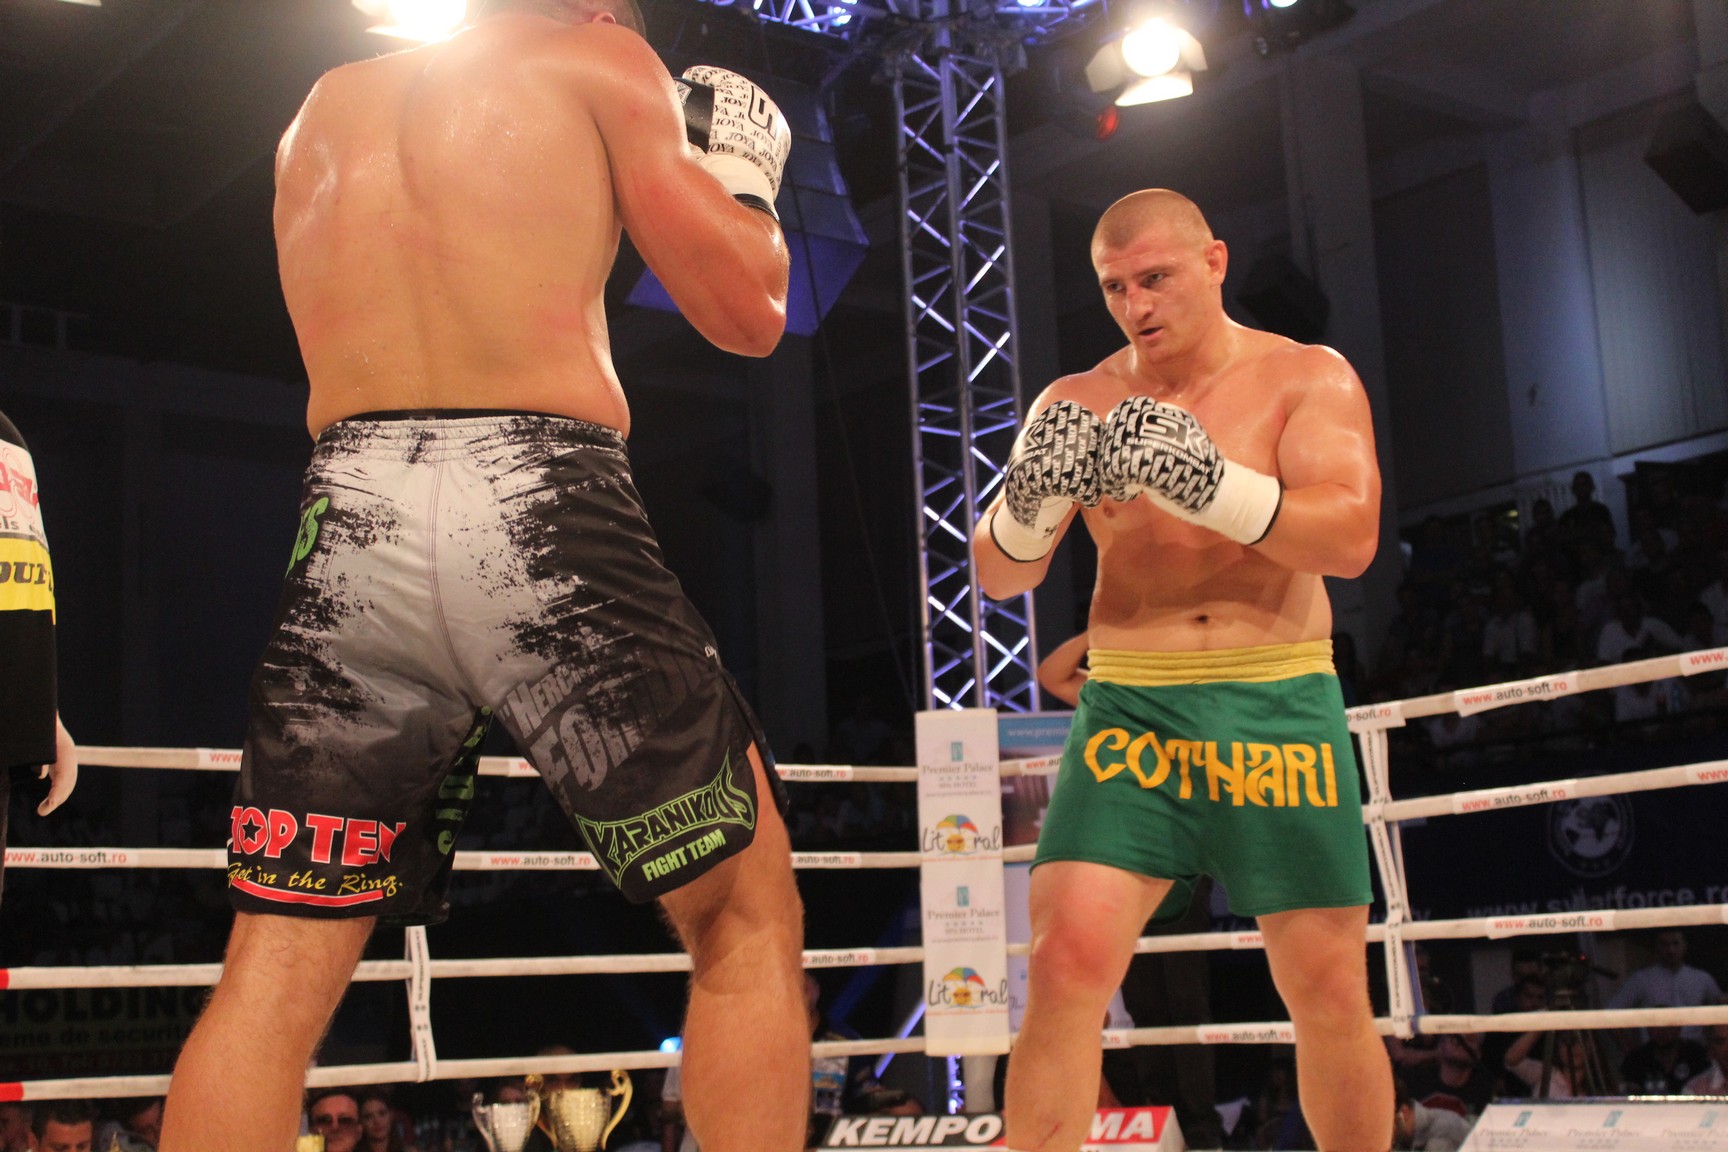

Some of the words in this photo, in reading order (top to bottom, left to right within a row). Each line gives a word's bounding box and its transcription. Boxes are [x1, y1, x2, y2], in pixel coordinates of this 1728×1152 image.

[1462, 680, 1567, 705] www.auto-soft.ro
[1083, 727, 1338, 807] COTNARI
[1461, 789, 1567, 812] www.auto-soft.ro
[230, 805, 298, 859] TOP
[305, 812, 407, 867] TEN
[490, 855, 591, 866] www.auto-soft.ro
[642, 848, 688, 882] FIGHT
[686, 828, 727, 861] TEAM
[227, 862, 252, 888] Get
[256, 865, 277, 885] in
[288, 869, 327, 890] the
[337, 874, 403, 898] Ring.
[927, 910, 967, 920] Premier
[970, 908, 1000, 918] Palace
[1494, 915, 1603, 930] www.auto-soft.ro
[828, 1115, 1004, 1147] KEMPO
